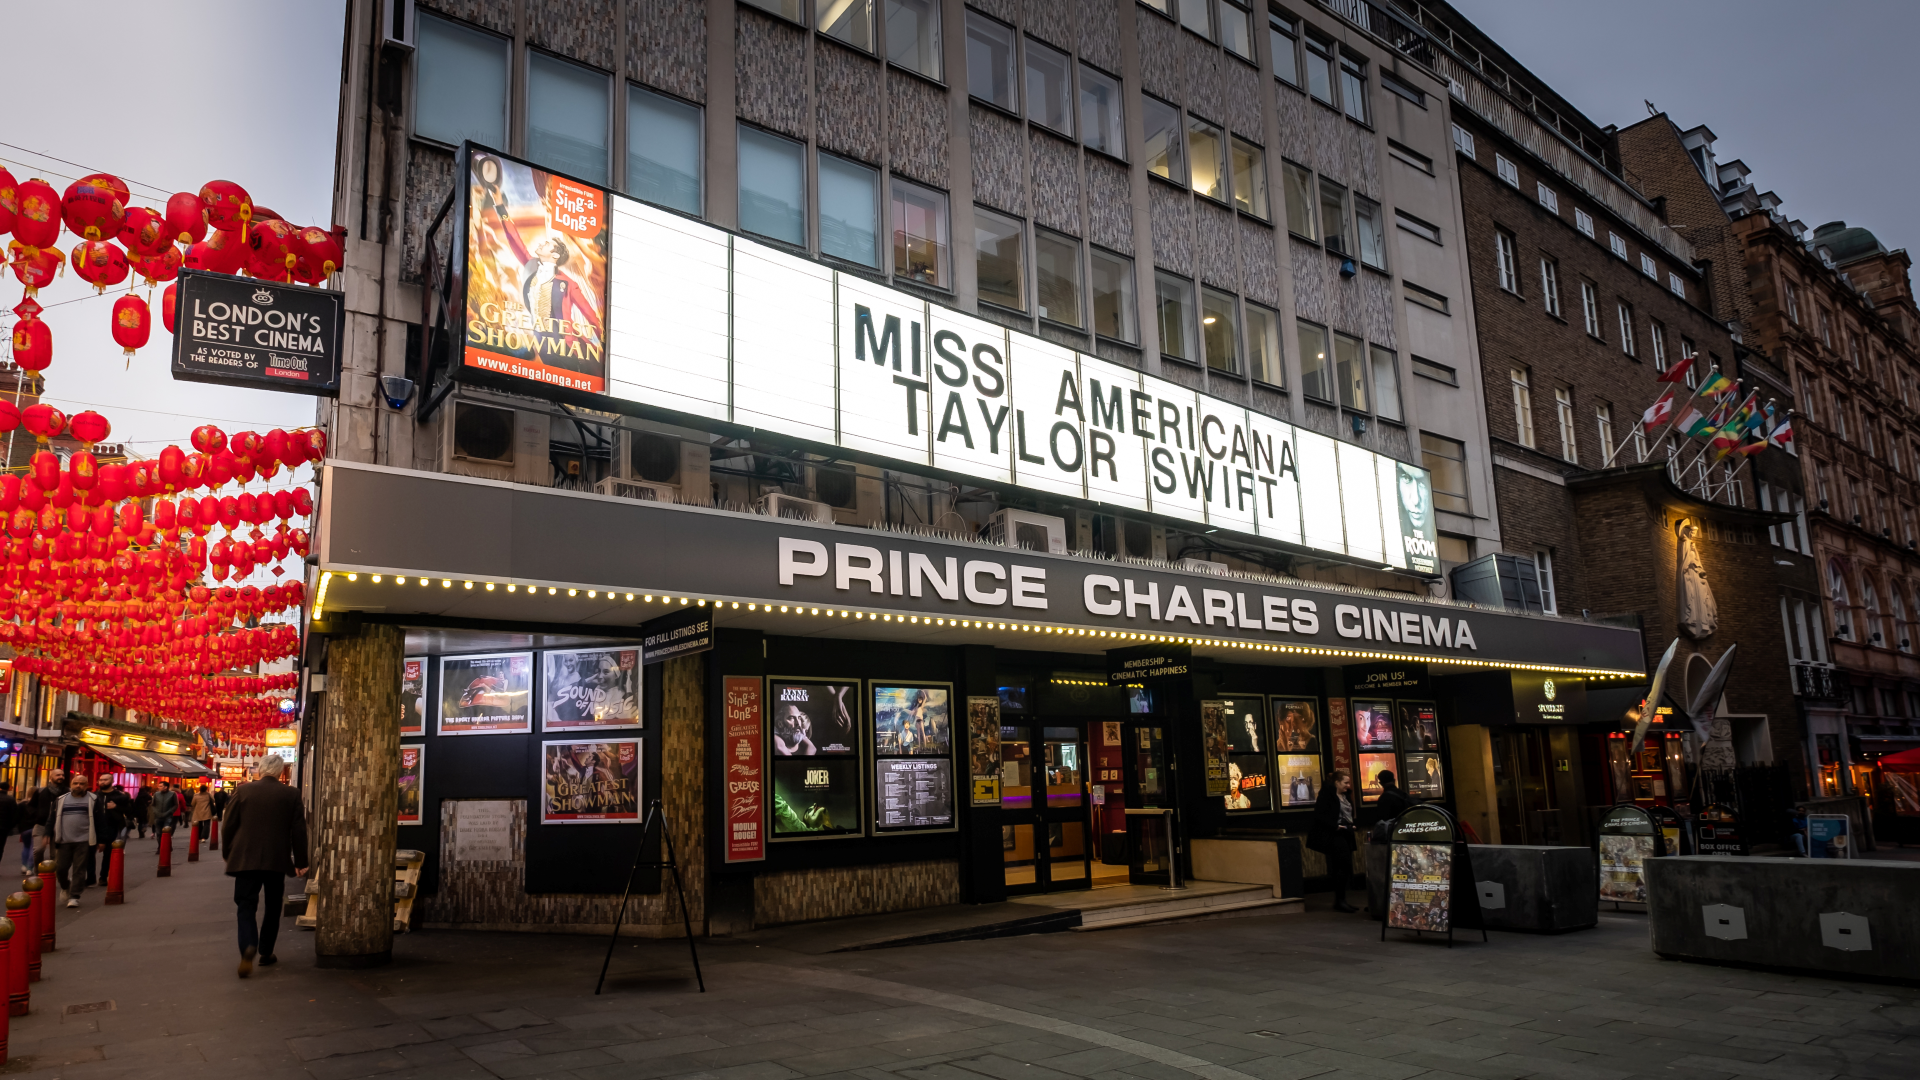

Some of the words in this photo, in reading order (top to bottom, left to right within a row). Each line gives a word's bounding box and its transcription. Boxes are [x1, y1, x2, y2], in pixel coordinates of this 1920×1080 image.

[555, 188, 598, 213] Sing-a-
[555, 206, 597, 231] Long-a
[504, 301, 523, 310] THE
[194, 299, 321, 334] LONDON'S
[480, 302, 597, 340] GREATEST
[192, 319, 245, 342] BEST
[254, 329, 325, 353] CINEMA
[467, 320, 600, 362] SHOWMAN
[197, 347, 208, 355] AS
[211, 349, 241, 359] VOTED
[190, 354, 206, 363] THE
[208, 356, 243, 367] READERS
[246, 361, 259, 369] OF
[269, 353, 290, 368] Time
[290, 356, 308, 371] Out
[274, 368, 300, 378] London
[477, 356, 592, 391] www.singalonga.net
[854, 302, 1005, 398] MISS
[1054, 369, 1300, 483] AMERICANA
[892, 374, 1119, 483] TAYLOR
[1151, 447, 1278, 519] SWIFT
[1413, 529, 1424, 539] THE
[1404, 536, 1438, 558] ROOM
[778, 536, 1048, 610] PRINCE
[1083, 573, 1320, 635] CHARLES
[1334, 603, 1478, 650] CINEMA
[645, 636, 656, 647] FOR
[656, 632, 670, 644] FULL
[670, 624, 696, 640] LISTINGS
[696, 620, 708, 633] SEE
[1124, 657, 1164, 668] MEMBERSHIP
[1112, 670, 1148, 680] CINEMATIC
[1150, 665, 1188, 676] HAPPINESS
[1366, 673, 1388, 682] JOIN
[1391, 672, 1405, 680] US!
[552, 684, 606, 708] SOUND
[728, 692, 758, 707] Sing-a-
[780, 694, 809, 702] RAMSAY
[576, 700, 588, 710] OF
[728, 705, 758, 720] Long-a
[804, 770, 829, 785] JOKER
[558, 778, 629, 796] GREATEST
[729, 781, 759, 793] GREASE
[551, 791, 632, 812] SHOWMAN
[733, 822, 757, 831] MOULIN
[734, 831, 756, 840] ROUGE!
[1392, 882, 1450, 890] MEMBERSHIP
